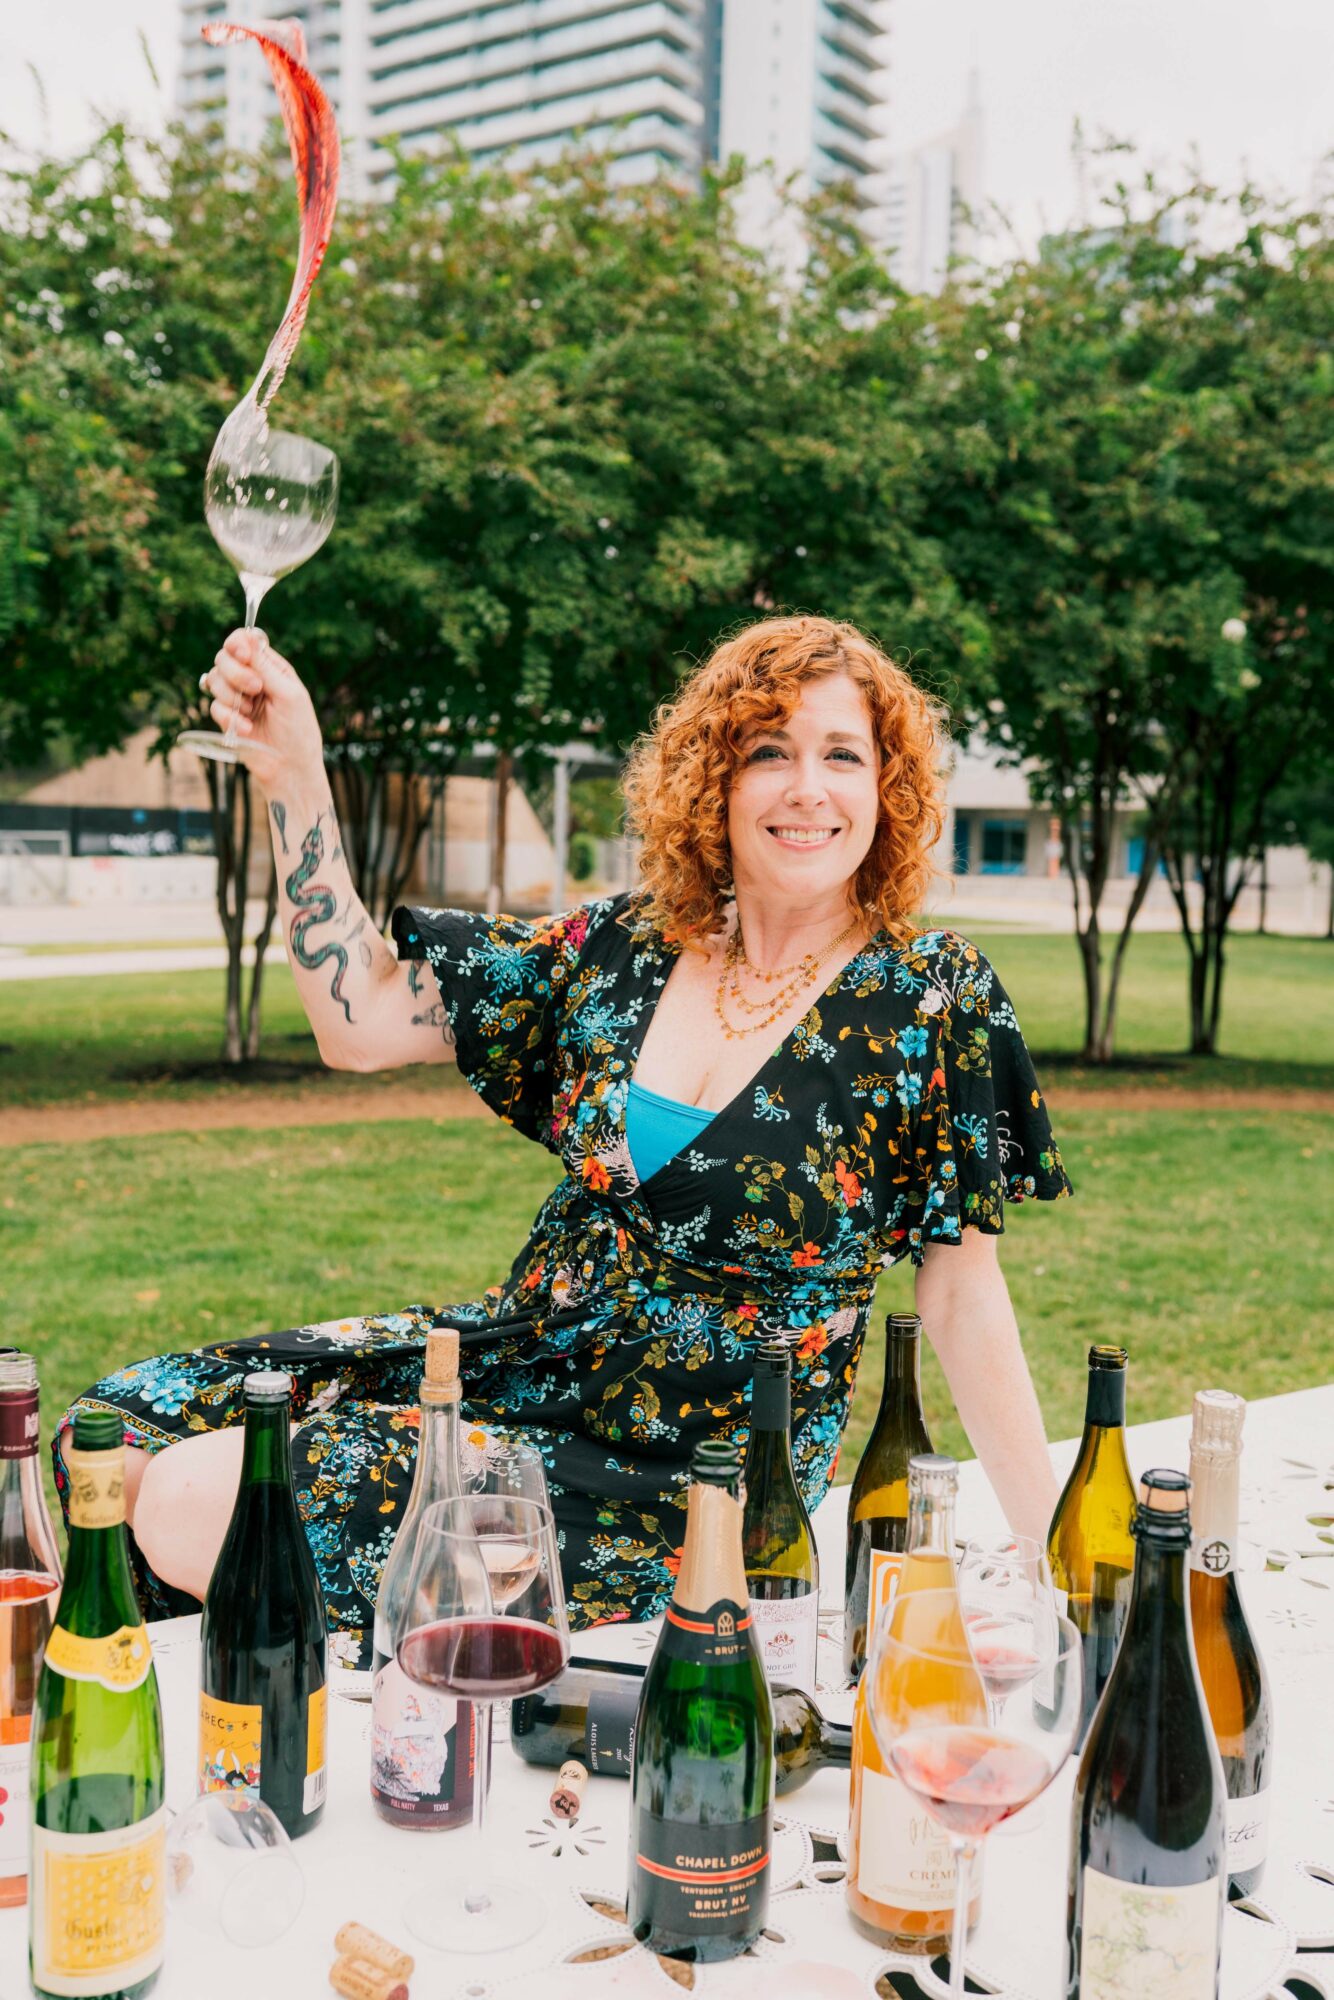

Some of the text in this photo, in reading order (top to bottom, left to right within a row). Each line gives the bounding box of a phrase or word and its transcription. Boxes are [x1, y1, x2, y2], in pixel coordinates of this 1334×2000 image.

[714, 1645, 739, 1655] BRUT
[766, 1664, 781, 1672] NOT
[433, 1802, 449, 1812] TEXAS
[675, 1846, 763, 1869] CHAPEL DOWN
[694, 1895, 747, 1910] BRUT NV
